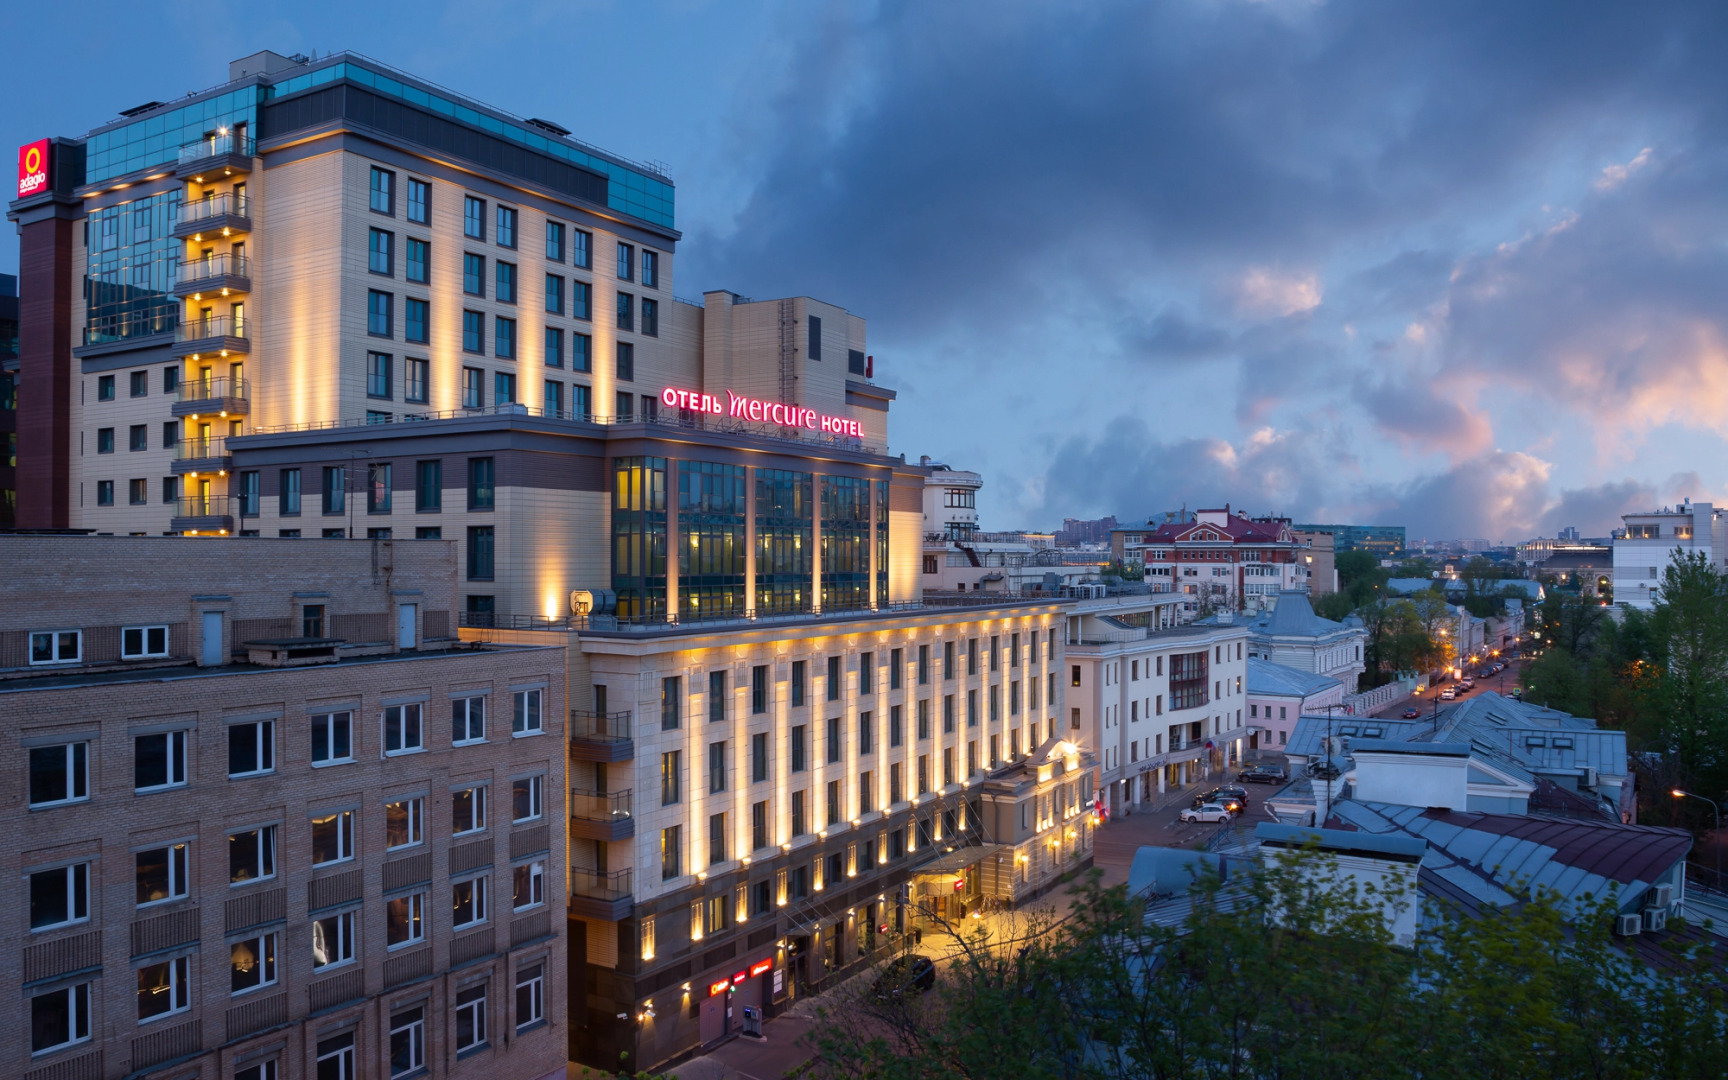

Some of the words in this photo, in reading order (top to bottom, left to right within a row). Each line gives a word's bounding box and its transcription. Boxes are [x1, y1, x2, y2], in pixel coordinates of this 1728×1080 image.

[19, 171, 46, 190] adagio
[662, 388, 722, 414] ОТЕЛЬ
[821, 416, 865, 437] HOTEL
